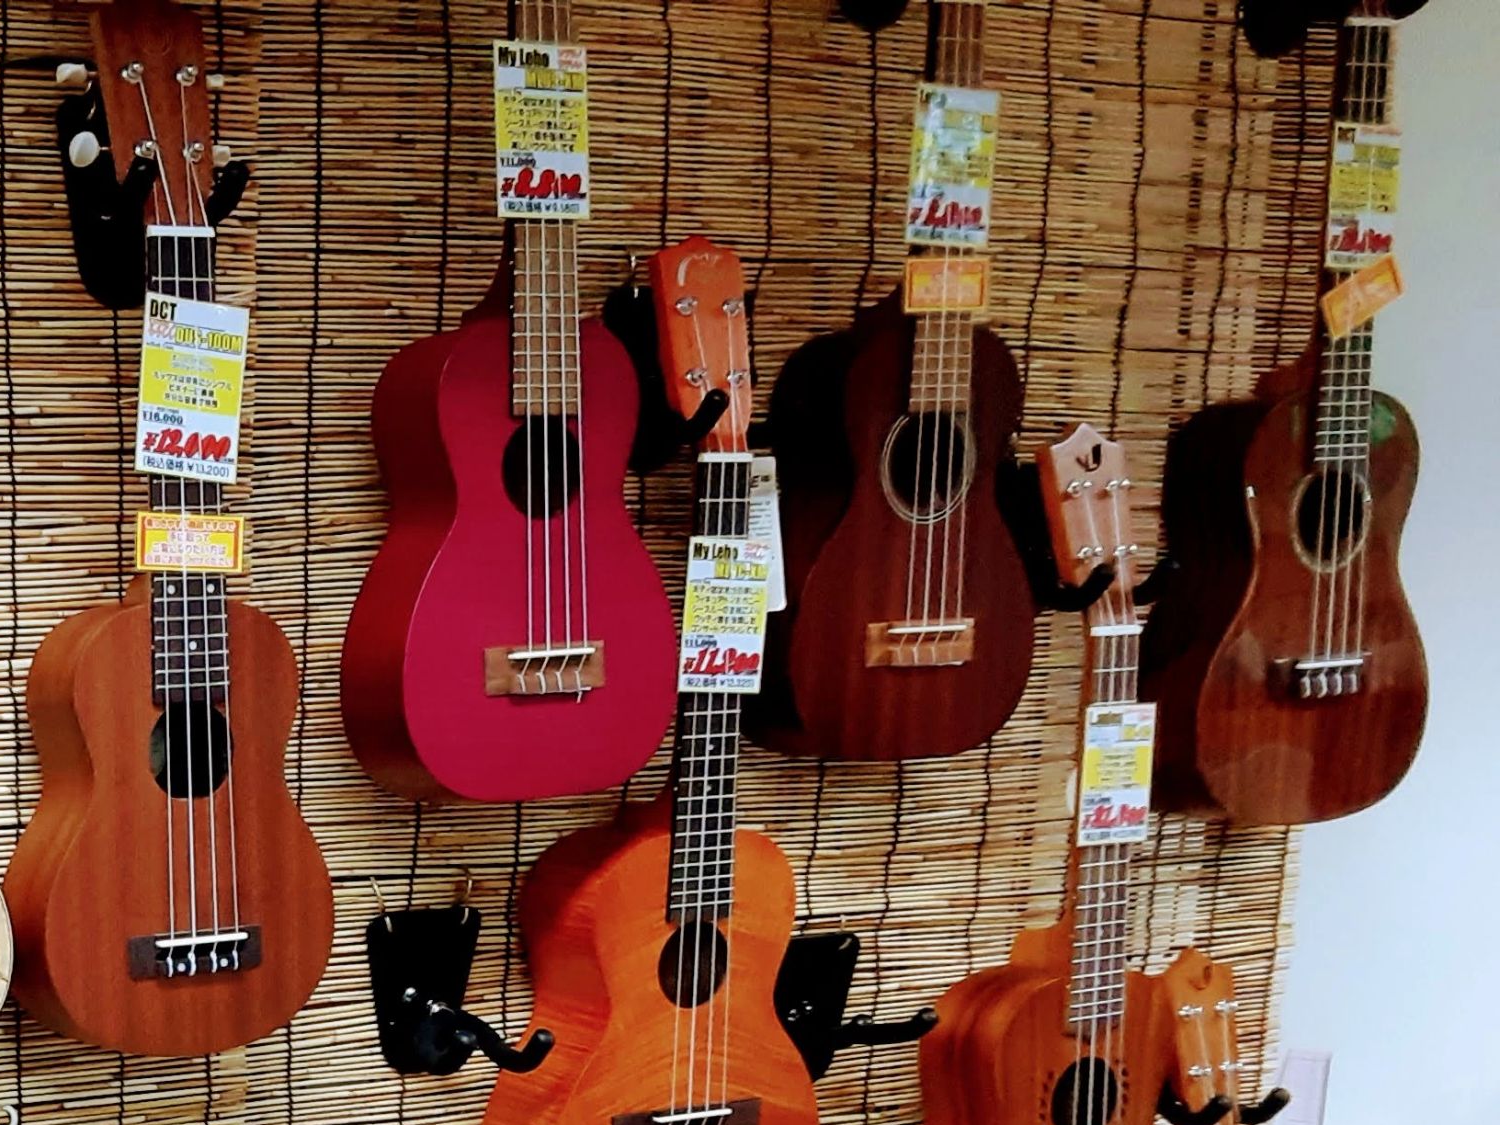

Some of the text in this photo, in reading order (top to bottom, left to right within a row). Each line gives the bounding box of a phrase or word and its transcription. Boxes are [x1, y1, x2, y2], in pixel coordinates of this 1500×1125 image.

[499, 46, 549, 68] My Leho
[150, 299, 178, 320] DCT
[142, 455, 184, 472] (税込価格
[692, 542, 740, 560] My Leho
